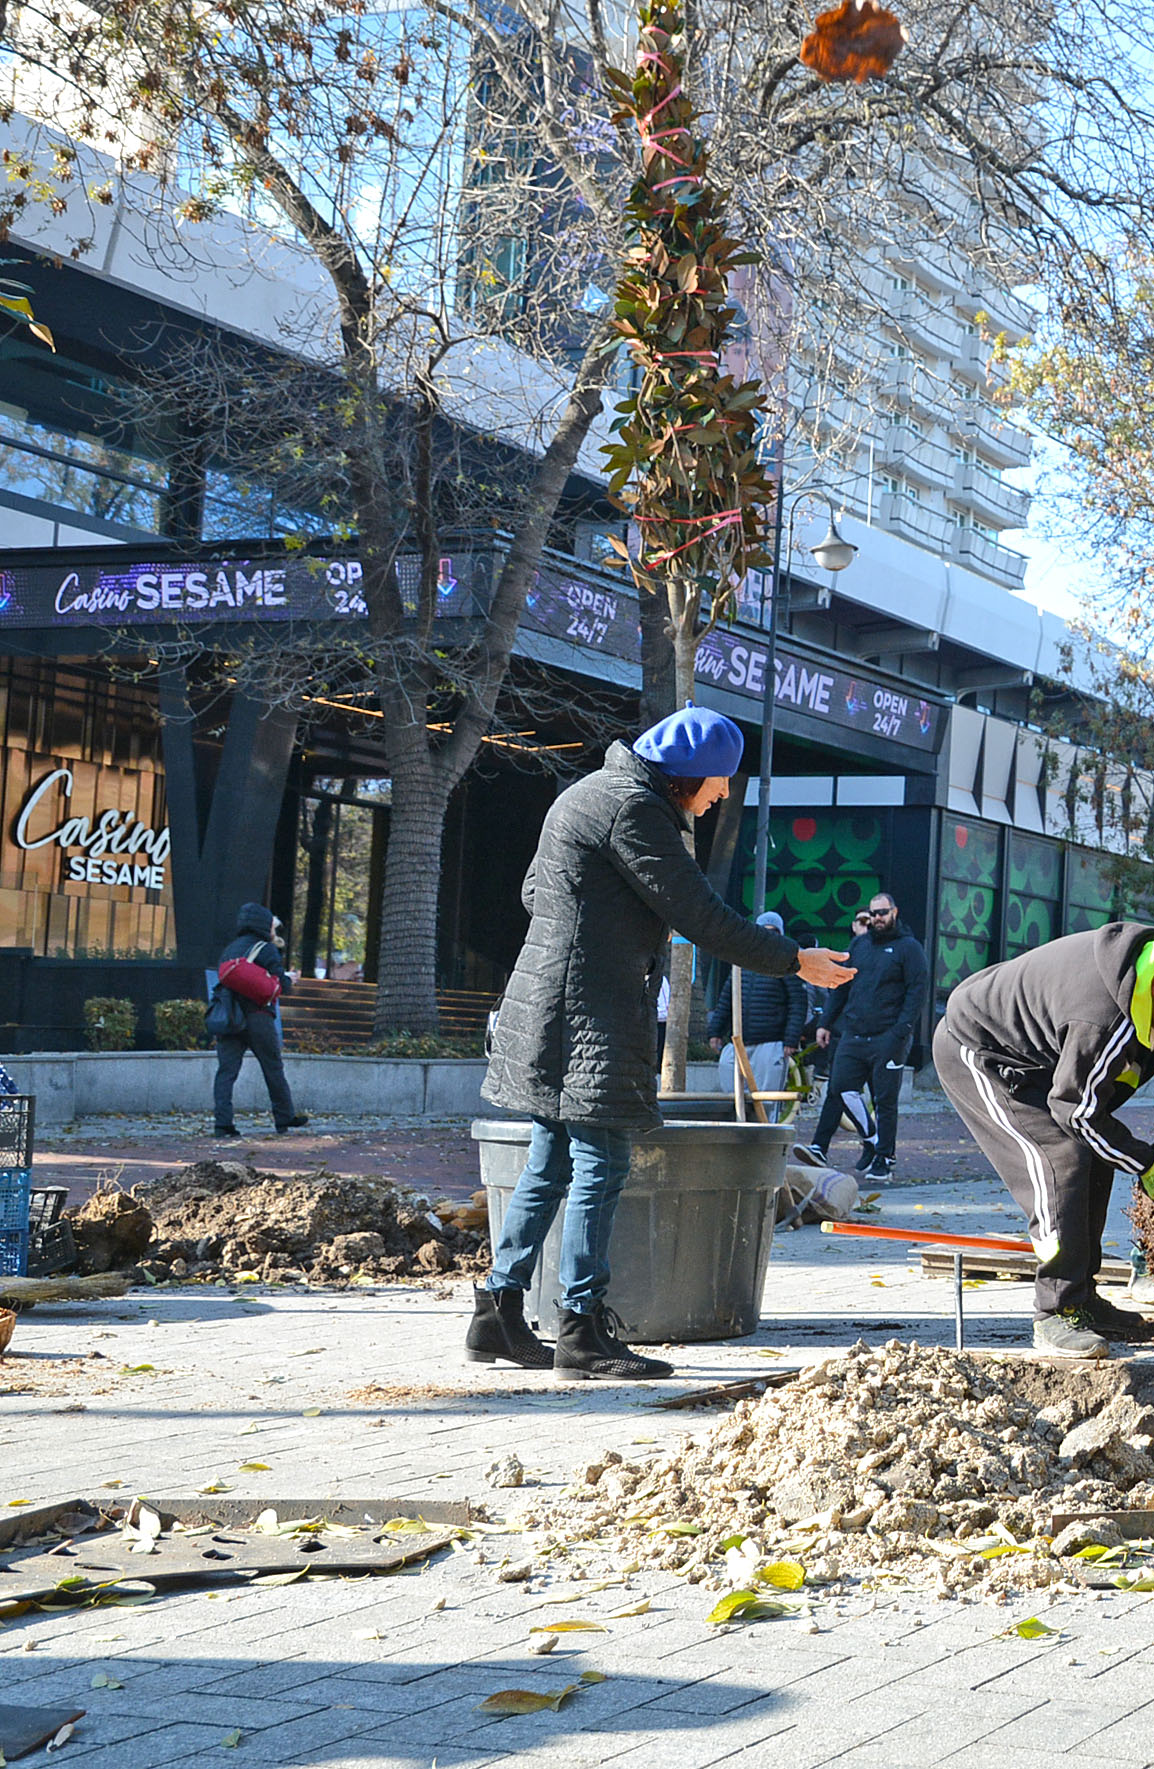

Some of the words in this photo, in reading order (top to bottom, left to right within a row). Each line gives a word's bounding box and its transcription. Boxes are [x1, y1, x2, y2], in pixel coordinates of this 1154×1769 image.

[55, 573, 135, 615] Casino
[136, 569, 288, 610] SESAME
[567, 585, 618, 620] OPEN
[566, 614, 609, 644] 24/7
[873, 690, 908, 717] OPEN
[872, 713, 902, 737] 24/7
[17, 768, 172, 865] Casino
[69, 855, 166, 890] SESAME
